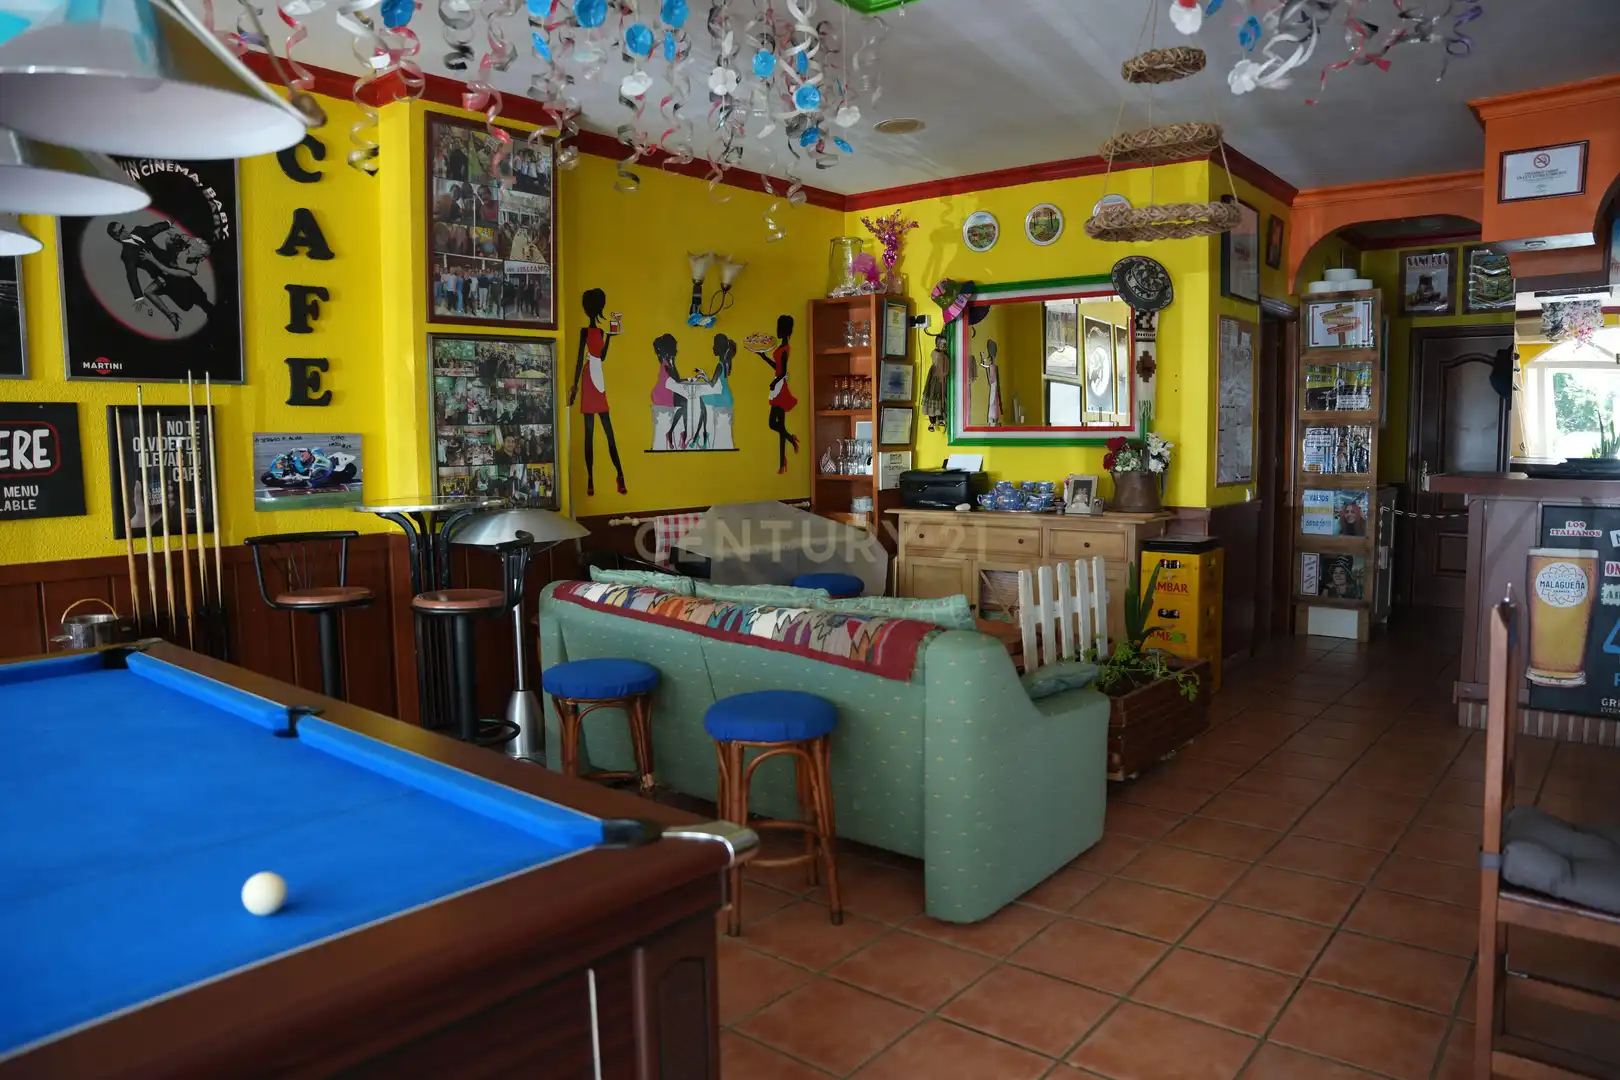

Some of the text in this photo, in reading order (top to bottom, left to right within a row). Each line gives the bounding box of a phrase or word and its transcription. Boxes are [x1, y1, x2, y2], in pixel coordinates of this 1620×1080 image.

[276, 133, 335, 406] CAFE
[82, 361, 123, 370] MARTINI
[166, 420, 184, 436] NO
[172, 466, 202, 482] CAF
[4, 484, 40, 498] MENU
[1551, 529, 1601, 537] ITALIANOS
[1154, 581, 1189, 594] MBAR
[1539, 580, 1586, 590] MALAGUEÑA
[1601, 698, 1620, 708] GR
